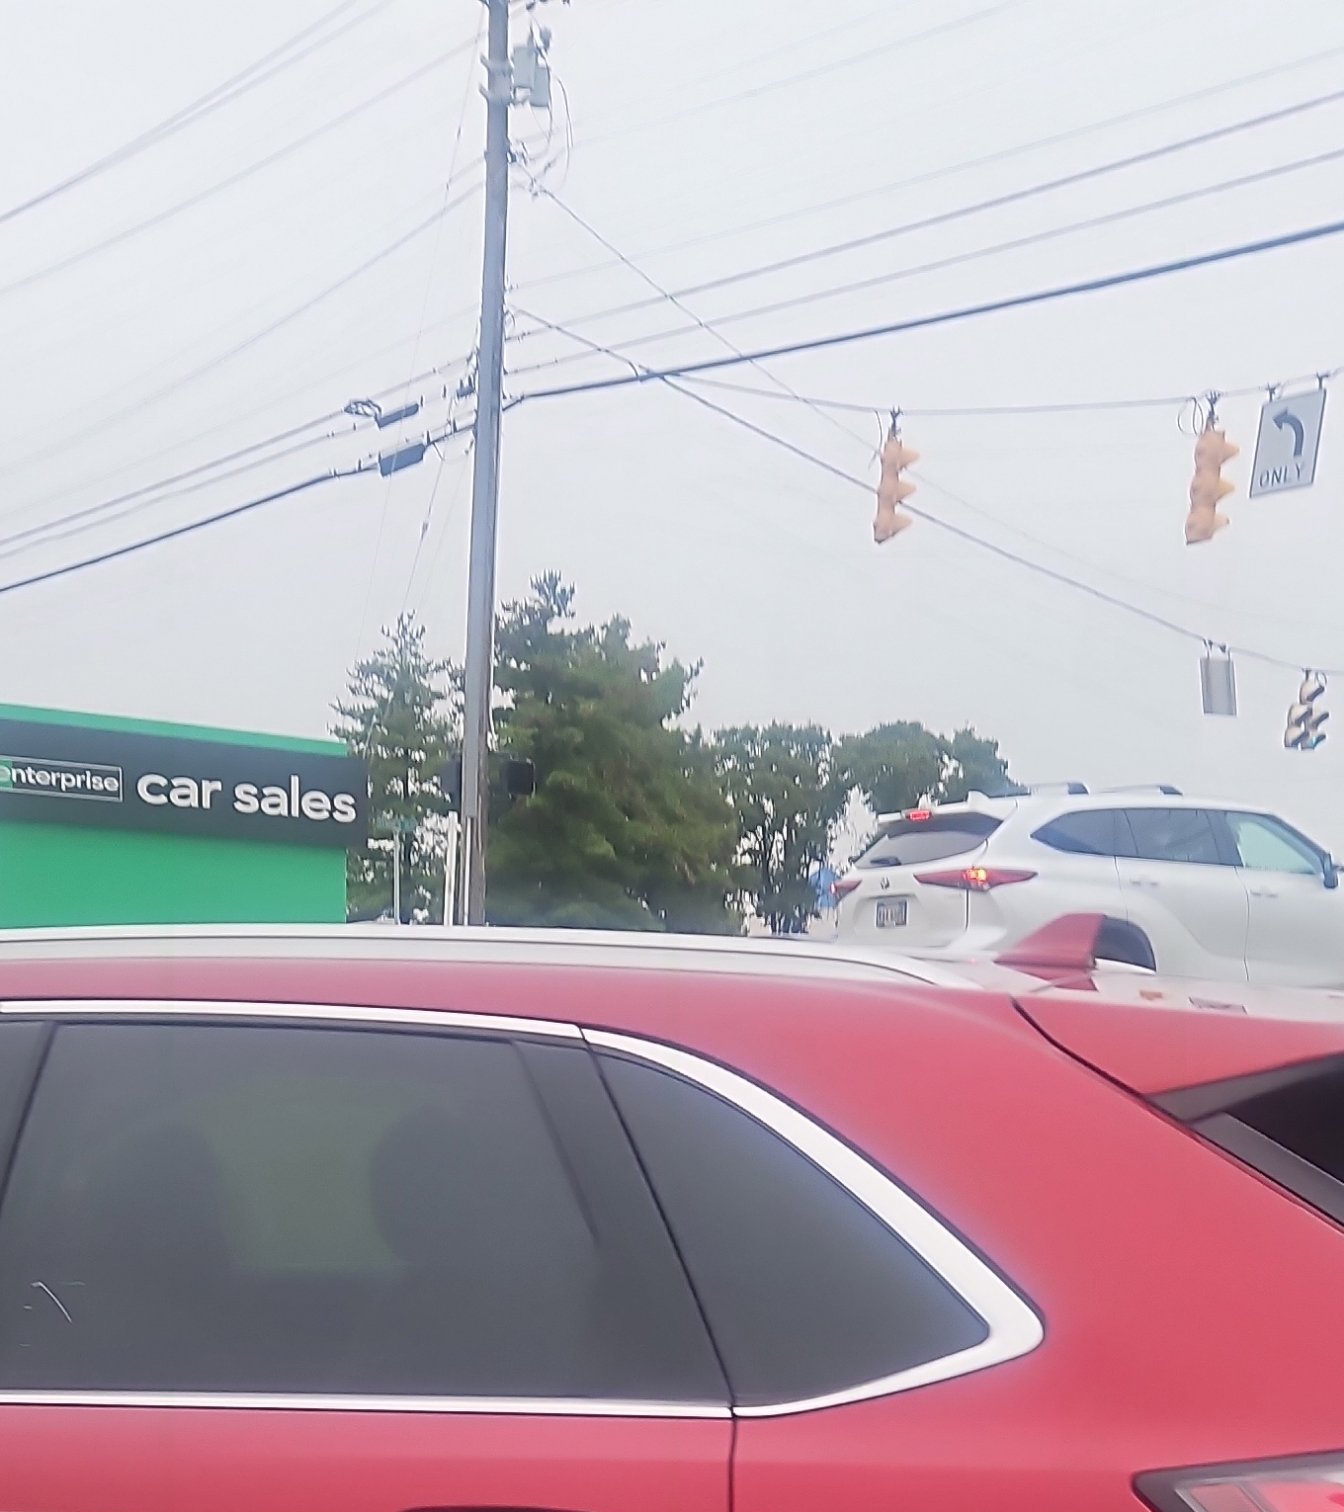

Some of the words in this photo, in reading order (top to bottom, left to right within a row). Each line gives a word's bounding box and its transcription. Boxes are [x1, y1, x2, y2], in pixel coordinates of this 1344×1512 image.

[1259, 463, 1306, 488] ONLY
[136, 773, 222, 809] car
[233, 774, 357, 823] sales
